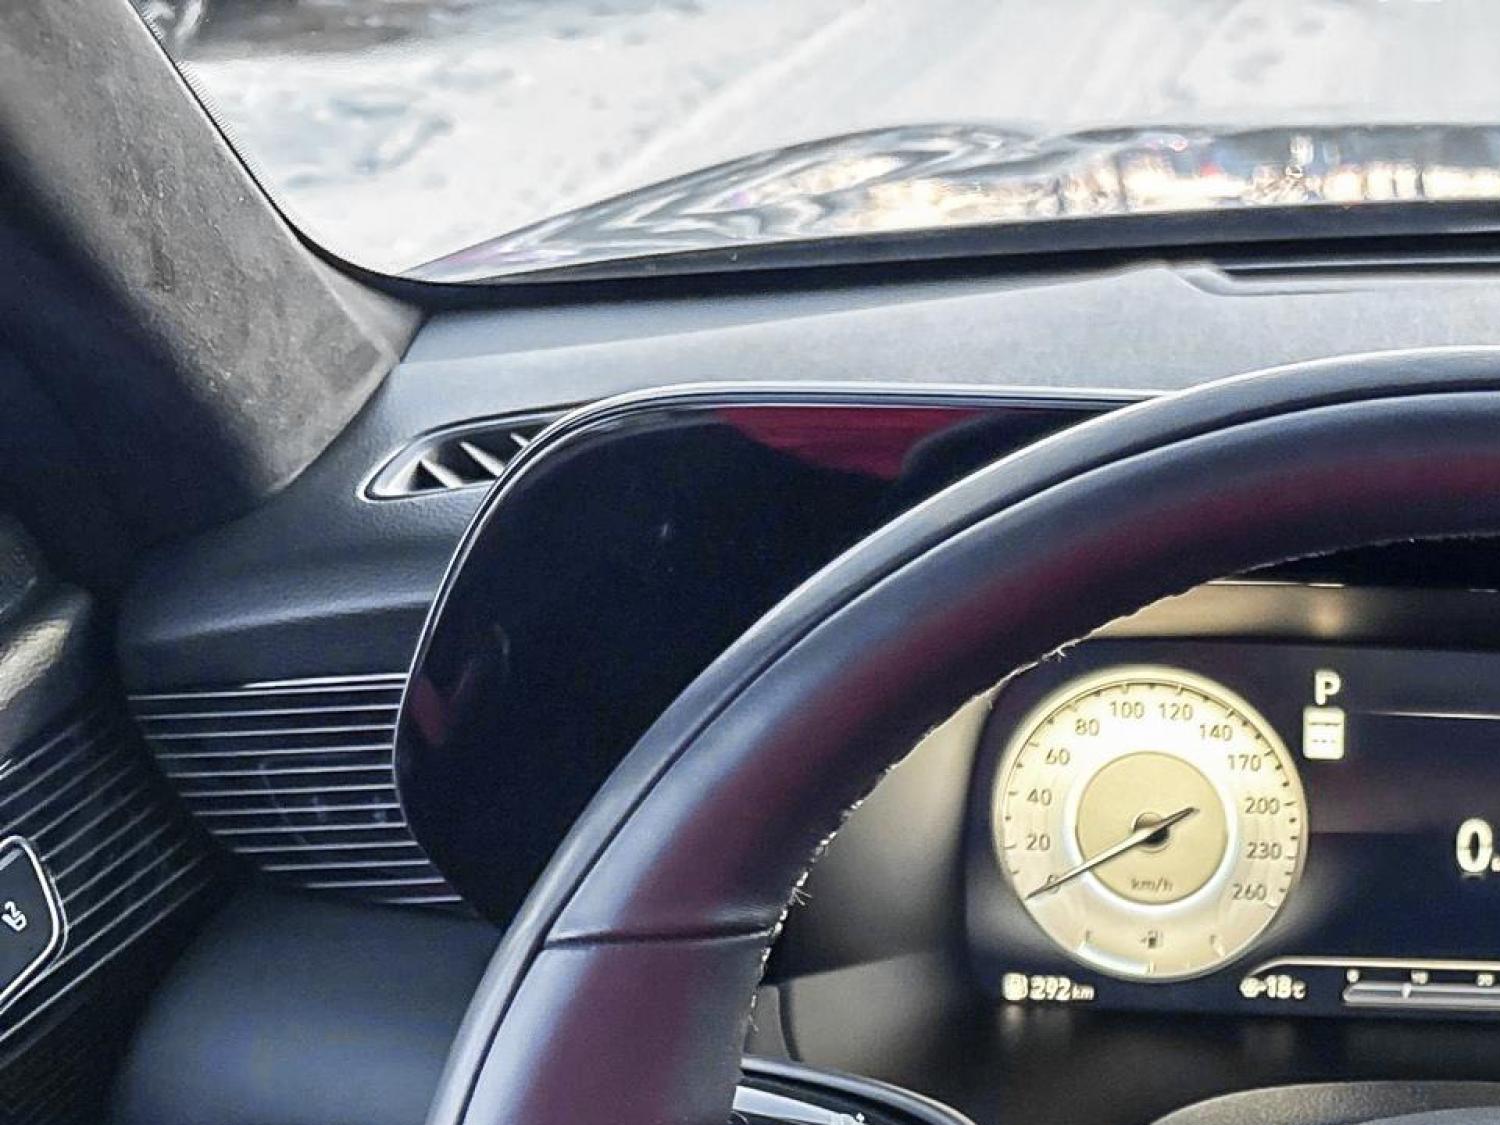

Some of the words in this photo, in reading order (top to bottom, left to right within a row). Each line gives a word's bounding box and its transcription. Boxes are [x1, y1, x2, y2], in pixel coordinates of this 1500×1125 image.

[1314, 669, 1341, 706] P
[1110, 701, 1145, 720] 100
[1159, 703, 1194, 722] 120
[1074, 718, 1100, 737] 80
[1199, 723, 1233, 742] 140
[1227, 754, 1262, 773] 170
[1026, 788, 1053, 807] 40
[1244, 797, 1281, 815] 200
[1025, 833, 1051, 851] 20
[1246, 841, 1283, 860] 230
[1456, 817, 1494, 875] 0
[1130, 877, 1174, 892] km/h
[1232, 883, 1268, 901] 260
